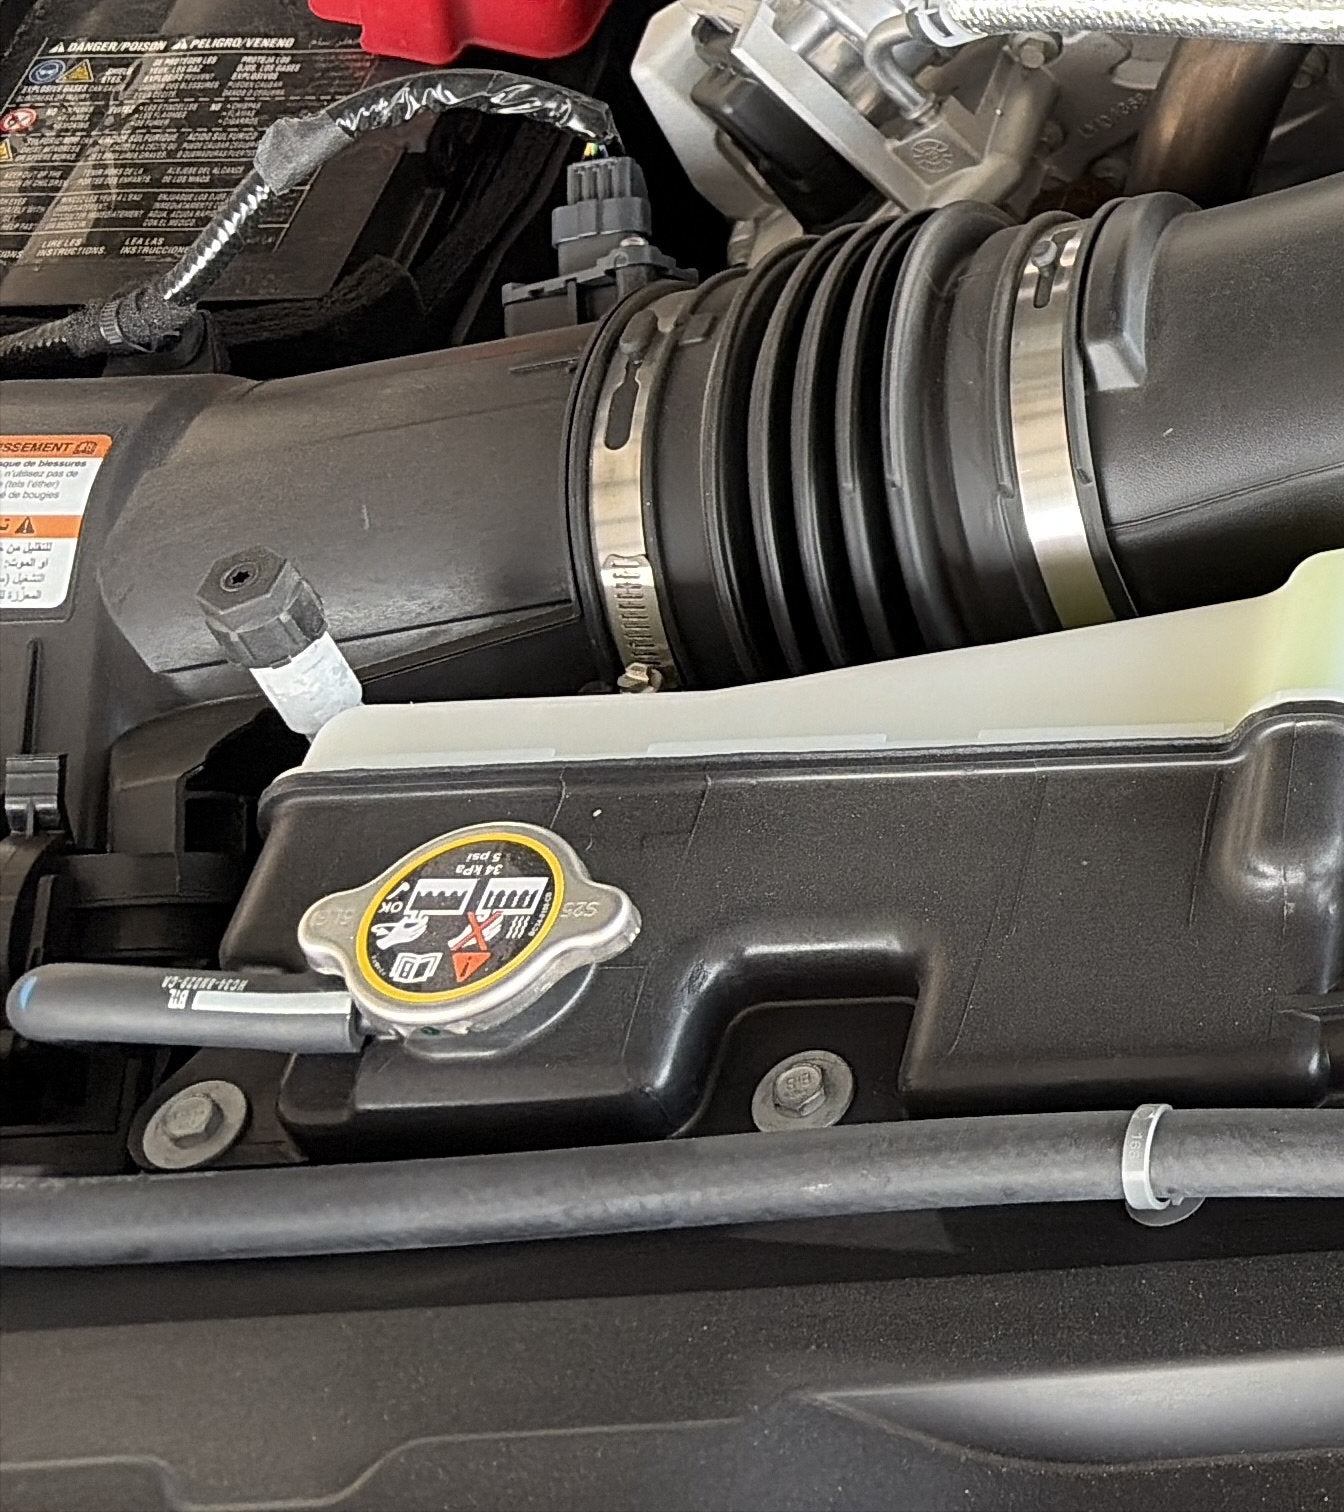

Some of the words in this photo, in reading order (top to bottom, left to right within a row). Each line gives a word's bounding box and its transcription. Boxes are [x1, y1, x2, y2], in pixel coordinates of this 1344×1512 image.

[67, 41, 168, 53] DANGER/POISON
[190, 38, 295, 49] PELIGRO/VENENO
[38, 459, 86, 468] blessures
[66, 470, 78, 478] de
[22, 490, 59, 502] bougies
[467, 852, 490, 864] psi
[491, 852, 503, 863] 5
[456, 864, 484, 877] kPa
[485, 864, 503, 876] 34
[379, 901, 403, 914] OK
